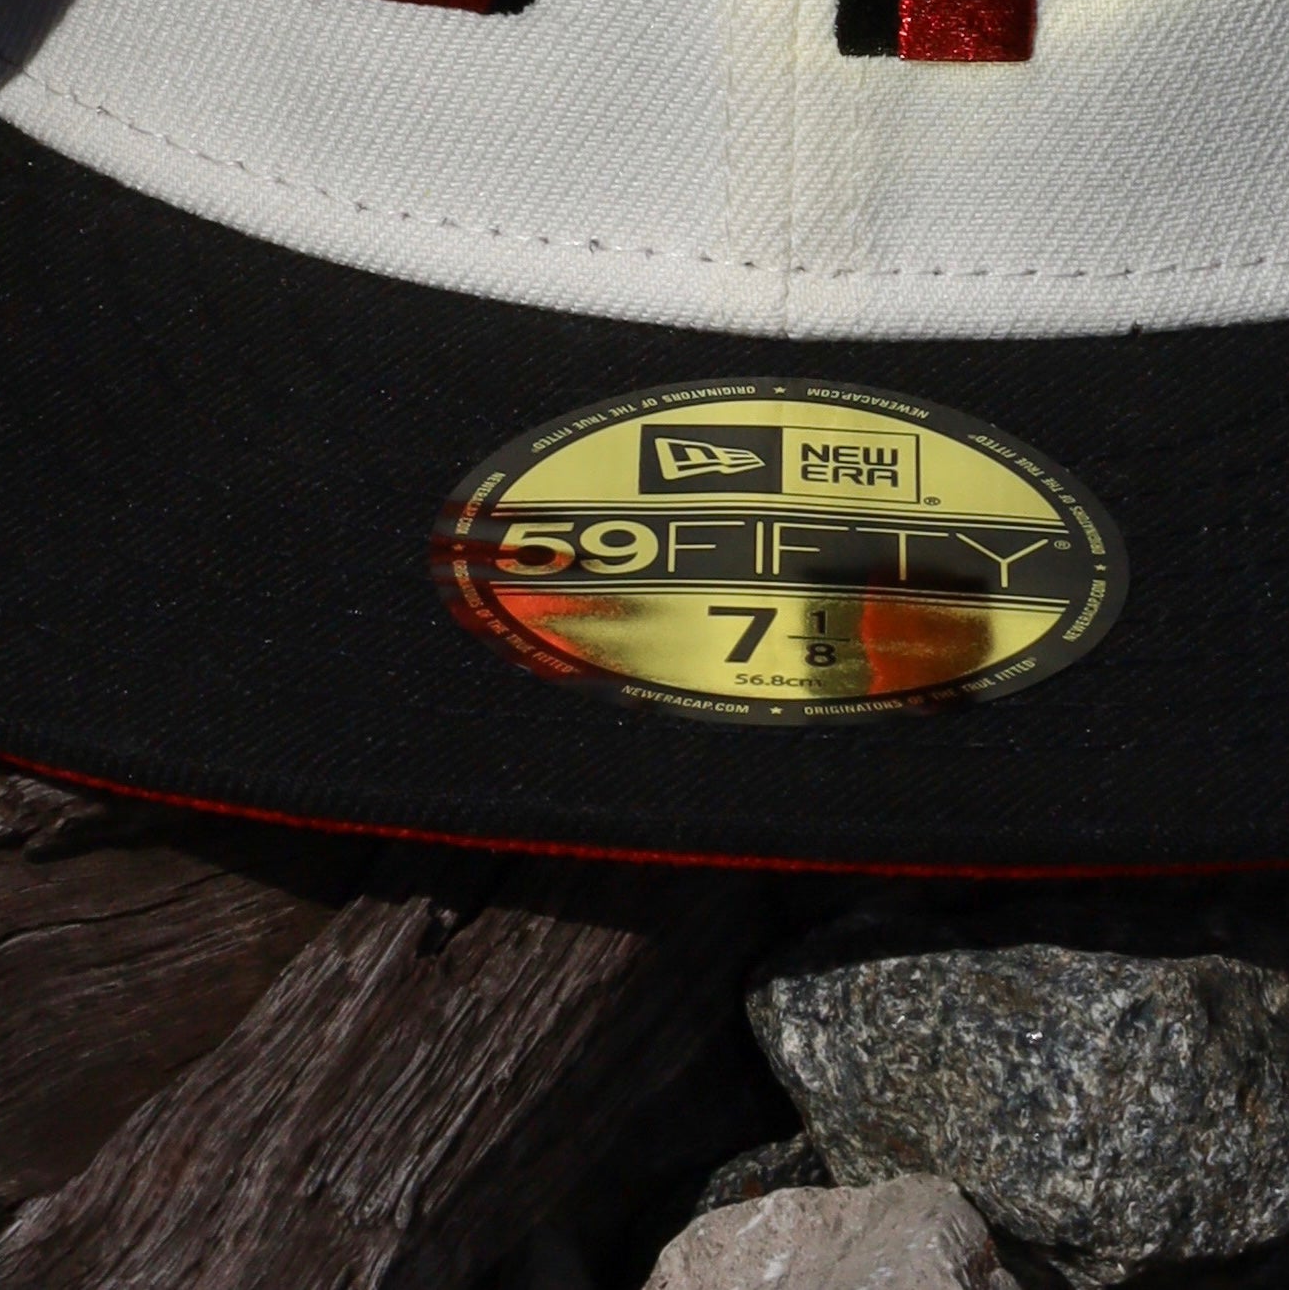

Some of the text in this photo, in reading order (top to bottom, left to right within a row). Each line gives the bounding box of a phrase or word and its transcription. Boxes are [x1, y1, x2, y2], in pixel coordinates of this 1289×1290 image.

[806, 387, 930, 420] NEWERACAP.COM
[532, 385, 756, 452] ORIGINATORS OF THE TRUE FITTED
[801, 442, 899, 467] NEW
[974, 434, 1018, 460] FITTED
[801, 464, 899, 488] ERA
[1013, 457, 1045, 478] TRUE
[1040, 477, 1064, 493] THE
[495, 520, 1050, 589] 59FIFTY
[708, 605, 779, 663] 7
[734, 673, 823, 688] 56.8cm
[803, 700, 903, 716] ORIGINATORS
[961, 677, 997, 693] TRUE
[993, 658, 1037, 682] FITTED
[621, 684, 750, 714] NEWERACAP.COM
